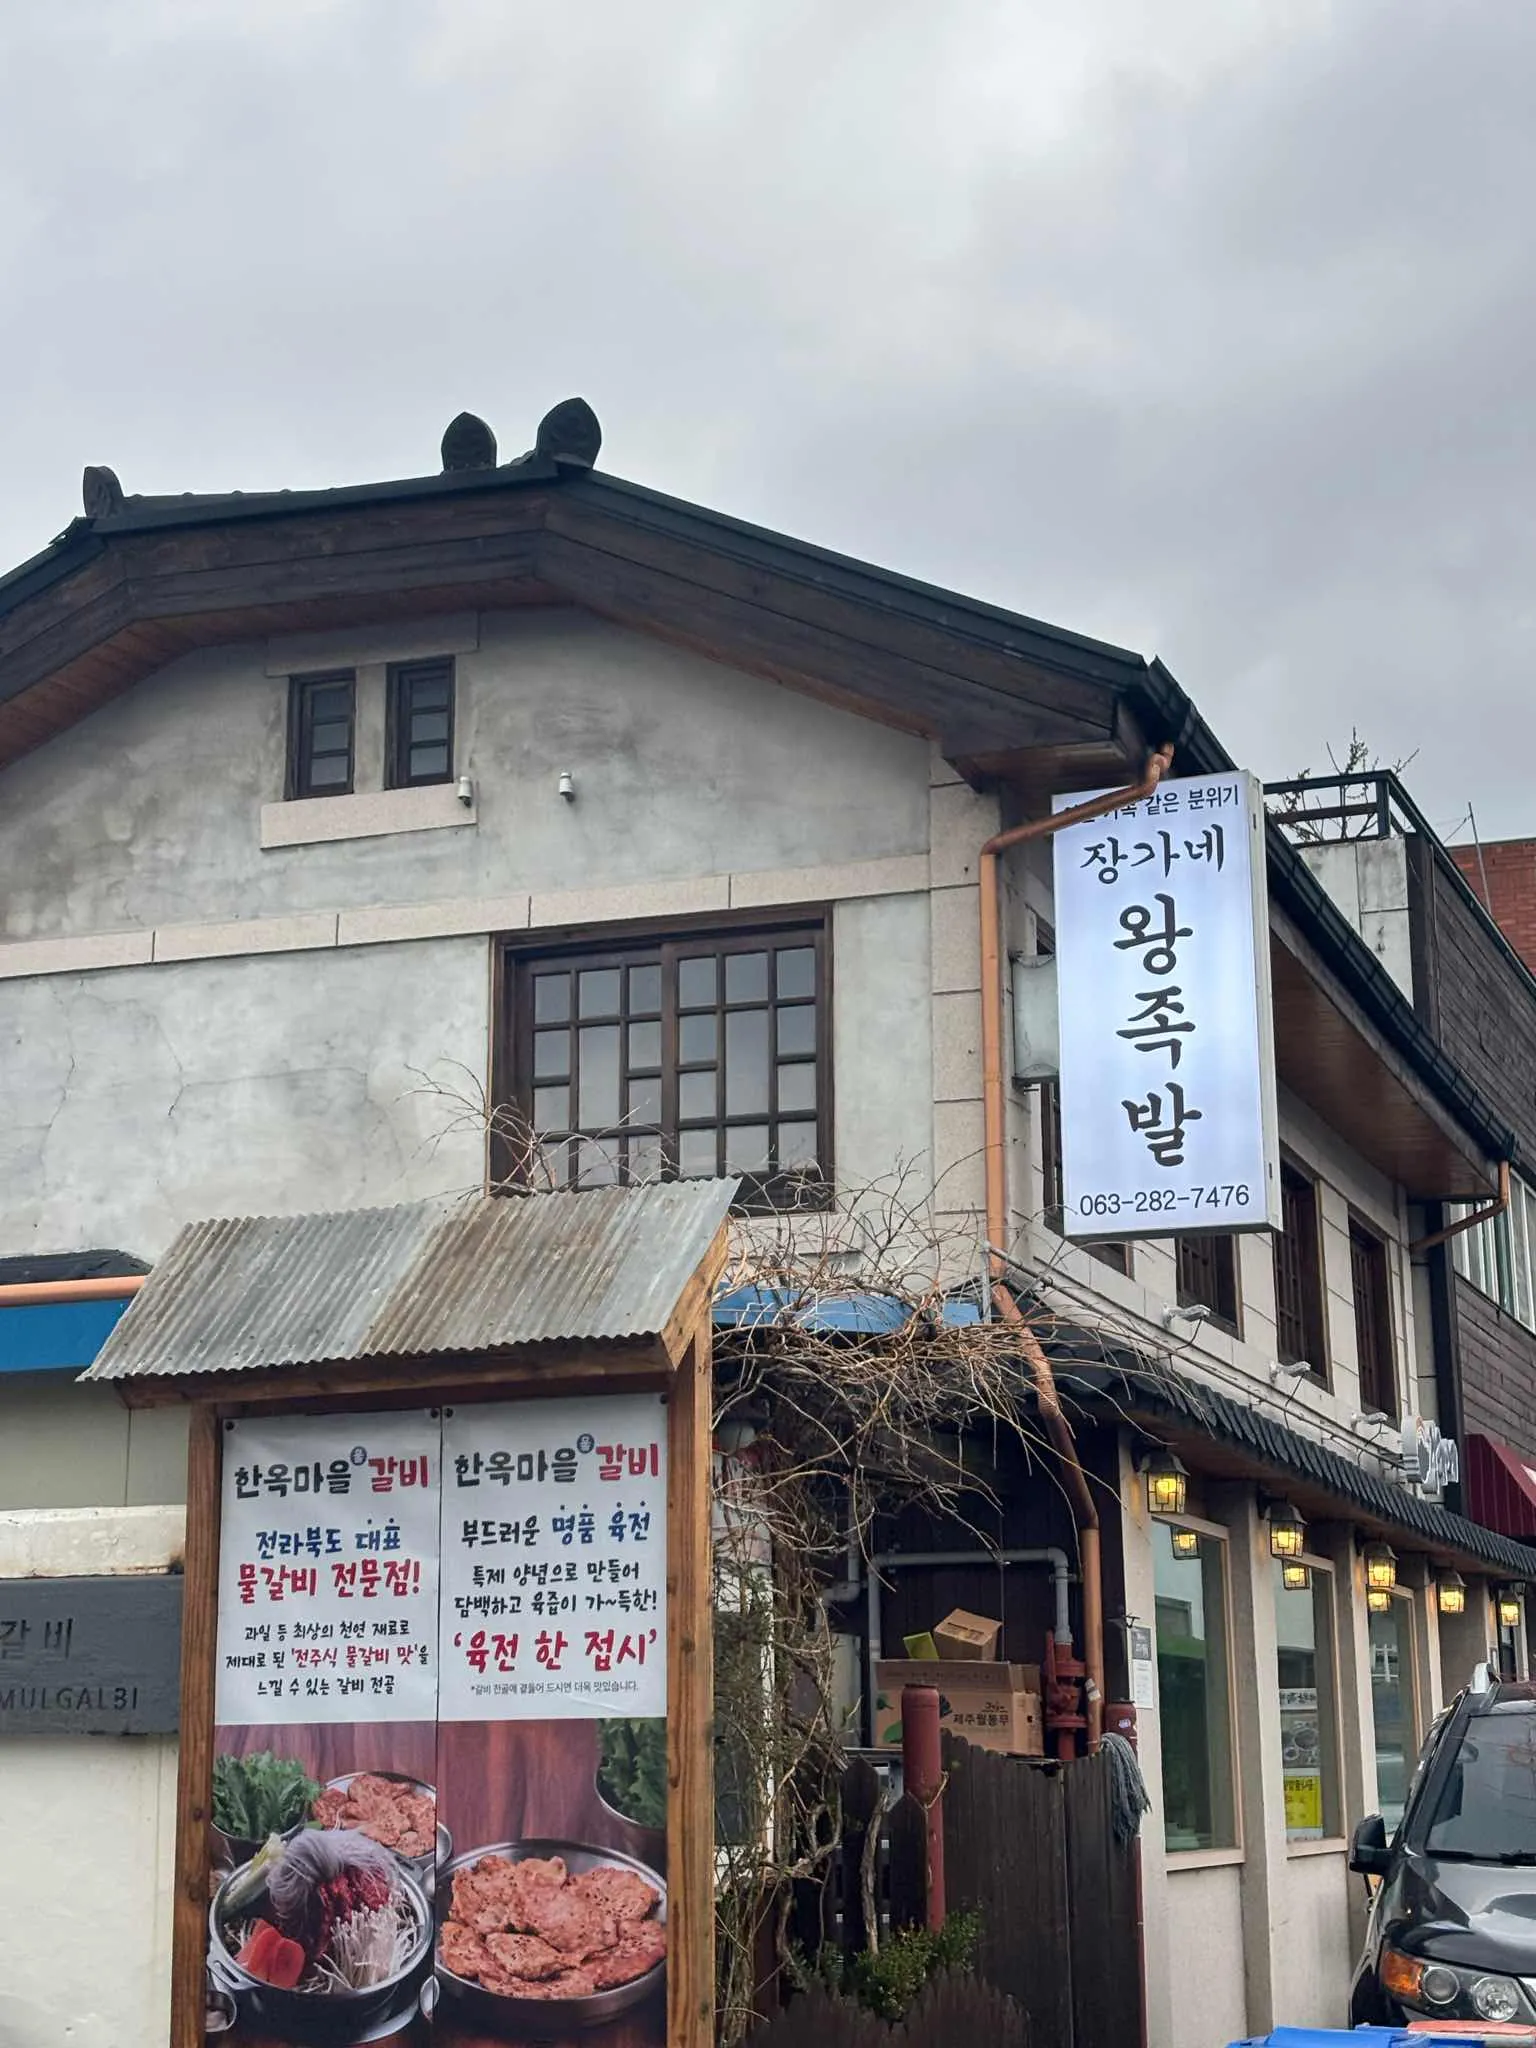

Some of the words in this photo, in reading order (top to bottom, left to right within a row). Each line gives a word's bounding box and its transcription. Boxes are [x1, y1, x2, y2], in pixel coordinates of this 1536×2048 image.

[1145, 792, 1180, 816] 같은
[1188, 784, 1238, 811] 분위기
[1080, 824, 1224, 884] 장가네
[1113, 893, 1203, 1167] 왕족발
[1079, 1184, 1250, 1216] 063-282-7476
[234, 1460, 352, 1499] 한옥마을
[368, 1455, 429, 1493] 갈비
[454, 1447, 578, 1487] 한옥마을
[595, 1443, 659, 1481] 갈비
[256, 1526, 343, 1560] 전라북도
[354, 1523, 400, 1551] 대표
[461, 1515, 540, 1548] 부드러운
[552, 1512, 596, 1546] 명품
[607, 1510, 651, 1542] 육전
[237, 1563, 317, 1604] 물갈비
[331, 1558, 421, 1598] 전문점!
[472, 1565, 505, 1588] 특제
[513, 1562, 579, 1587] 양념으로
[587, 1559, 639, 1583] 만들어
[454, 1594, 522, 1618] 담백하고
[531, 1591, 576, 1615] 육즙이
[585, 1588, 657, 1613] 가~득한!
[244, 1624, 271, 1642] 과일
[277, 1624, 288, 1642] 등
[293, 1621, 334, 1641] 최상의
[339, 1620, 366, 1639] 천연
[372, 1619, 411, 1637] 재료로
[225, 1652, 267, 1669] 제대로
[272, 1651, 285, 1669] 된
[291, 1647, 338, 1669] '전주식
[346, 1646, 390, 1669] 물갈비
[534, 1629, 569, 1671] 한
[257, 1679, 283, 1696] 느낄
[289, 1678, 302, 1696] 수
[306, 1678, 330, 1696] 있는
[337, 1677, 364, 1695] 갈비
[370, 1675, 396, 1695] 전골
